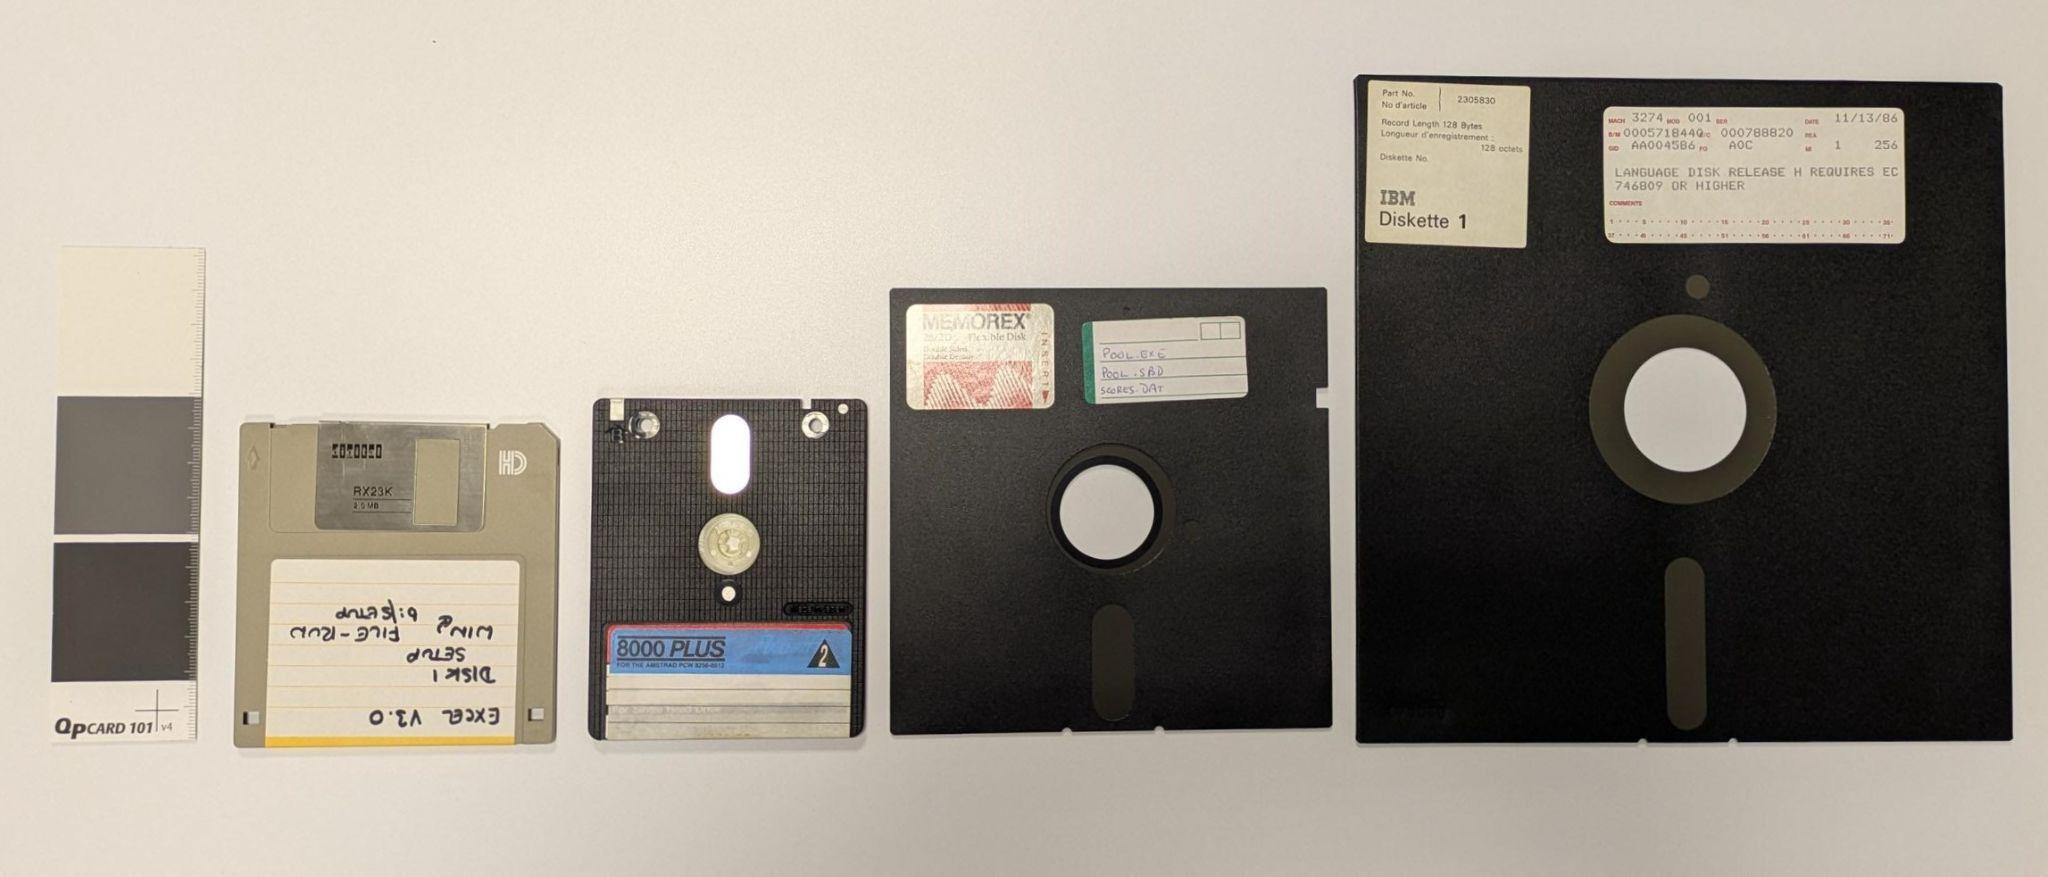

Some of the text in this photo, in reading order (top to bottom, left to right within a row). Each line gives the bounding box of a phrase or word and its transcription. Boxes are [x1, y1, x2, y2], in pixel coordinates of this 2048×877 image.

[1383, 89, 1398, 97] Part
[1382, 101, 1428, 110] No d'article
[1457, 95, 1496, 105] 2305830
[1632, 113, 1663, 122] 3274
[1688, 113, 1711, 122] 001
[1835, 113, 1898, 123] 11/13/86
[1382, 119, 1483, 131] Record Length 128 Bytes
[1381, 130, 1418, 140] Longueur
[1422, 131, 1489, 142] d'enregistrement
[1721, 128, 1794, 138] 000788820
[1481, 144, 1524, 153] 128 octets
[1835, 141, 1840, 150] 1
[1875, 140, 1898, 150] 256
[1380, 153, 1428, 162] Diskette No.
[1615, 167, 1899, 177] LANGUAGE DISK RELEASE H REQUIRES EC
[1615, 181, 1745, 191] 746809 OR HIGHER
[1380, 189, 1416, 206] IBM
[1379, 211, 1467, 229] Diskette 1
[922, 313, 1026, 330] MEMOREX
[1006, 332, 1026, 342] Disk
[499, 450, 527, 475] HD
[353, 486, 393, 497] RX23K
[617, 640, 726, 657] 8000 PLUS
[406, 646, 466, 663] SETUP
[817, 644, 829, 667] 2
[443, 666, 496, 684] DISK
[370, 707, 500, 728] EXCEL V3.0
[130, 722, 153, 734] 101
[161, 723, 173, 731] v4
